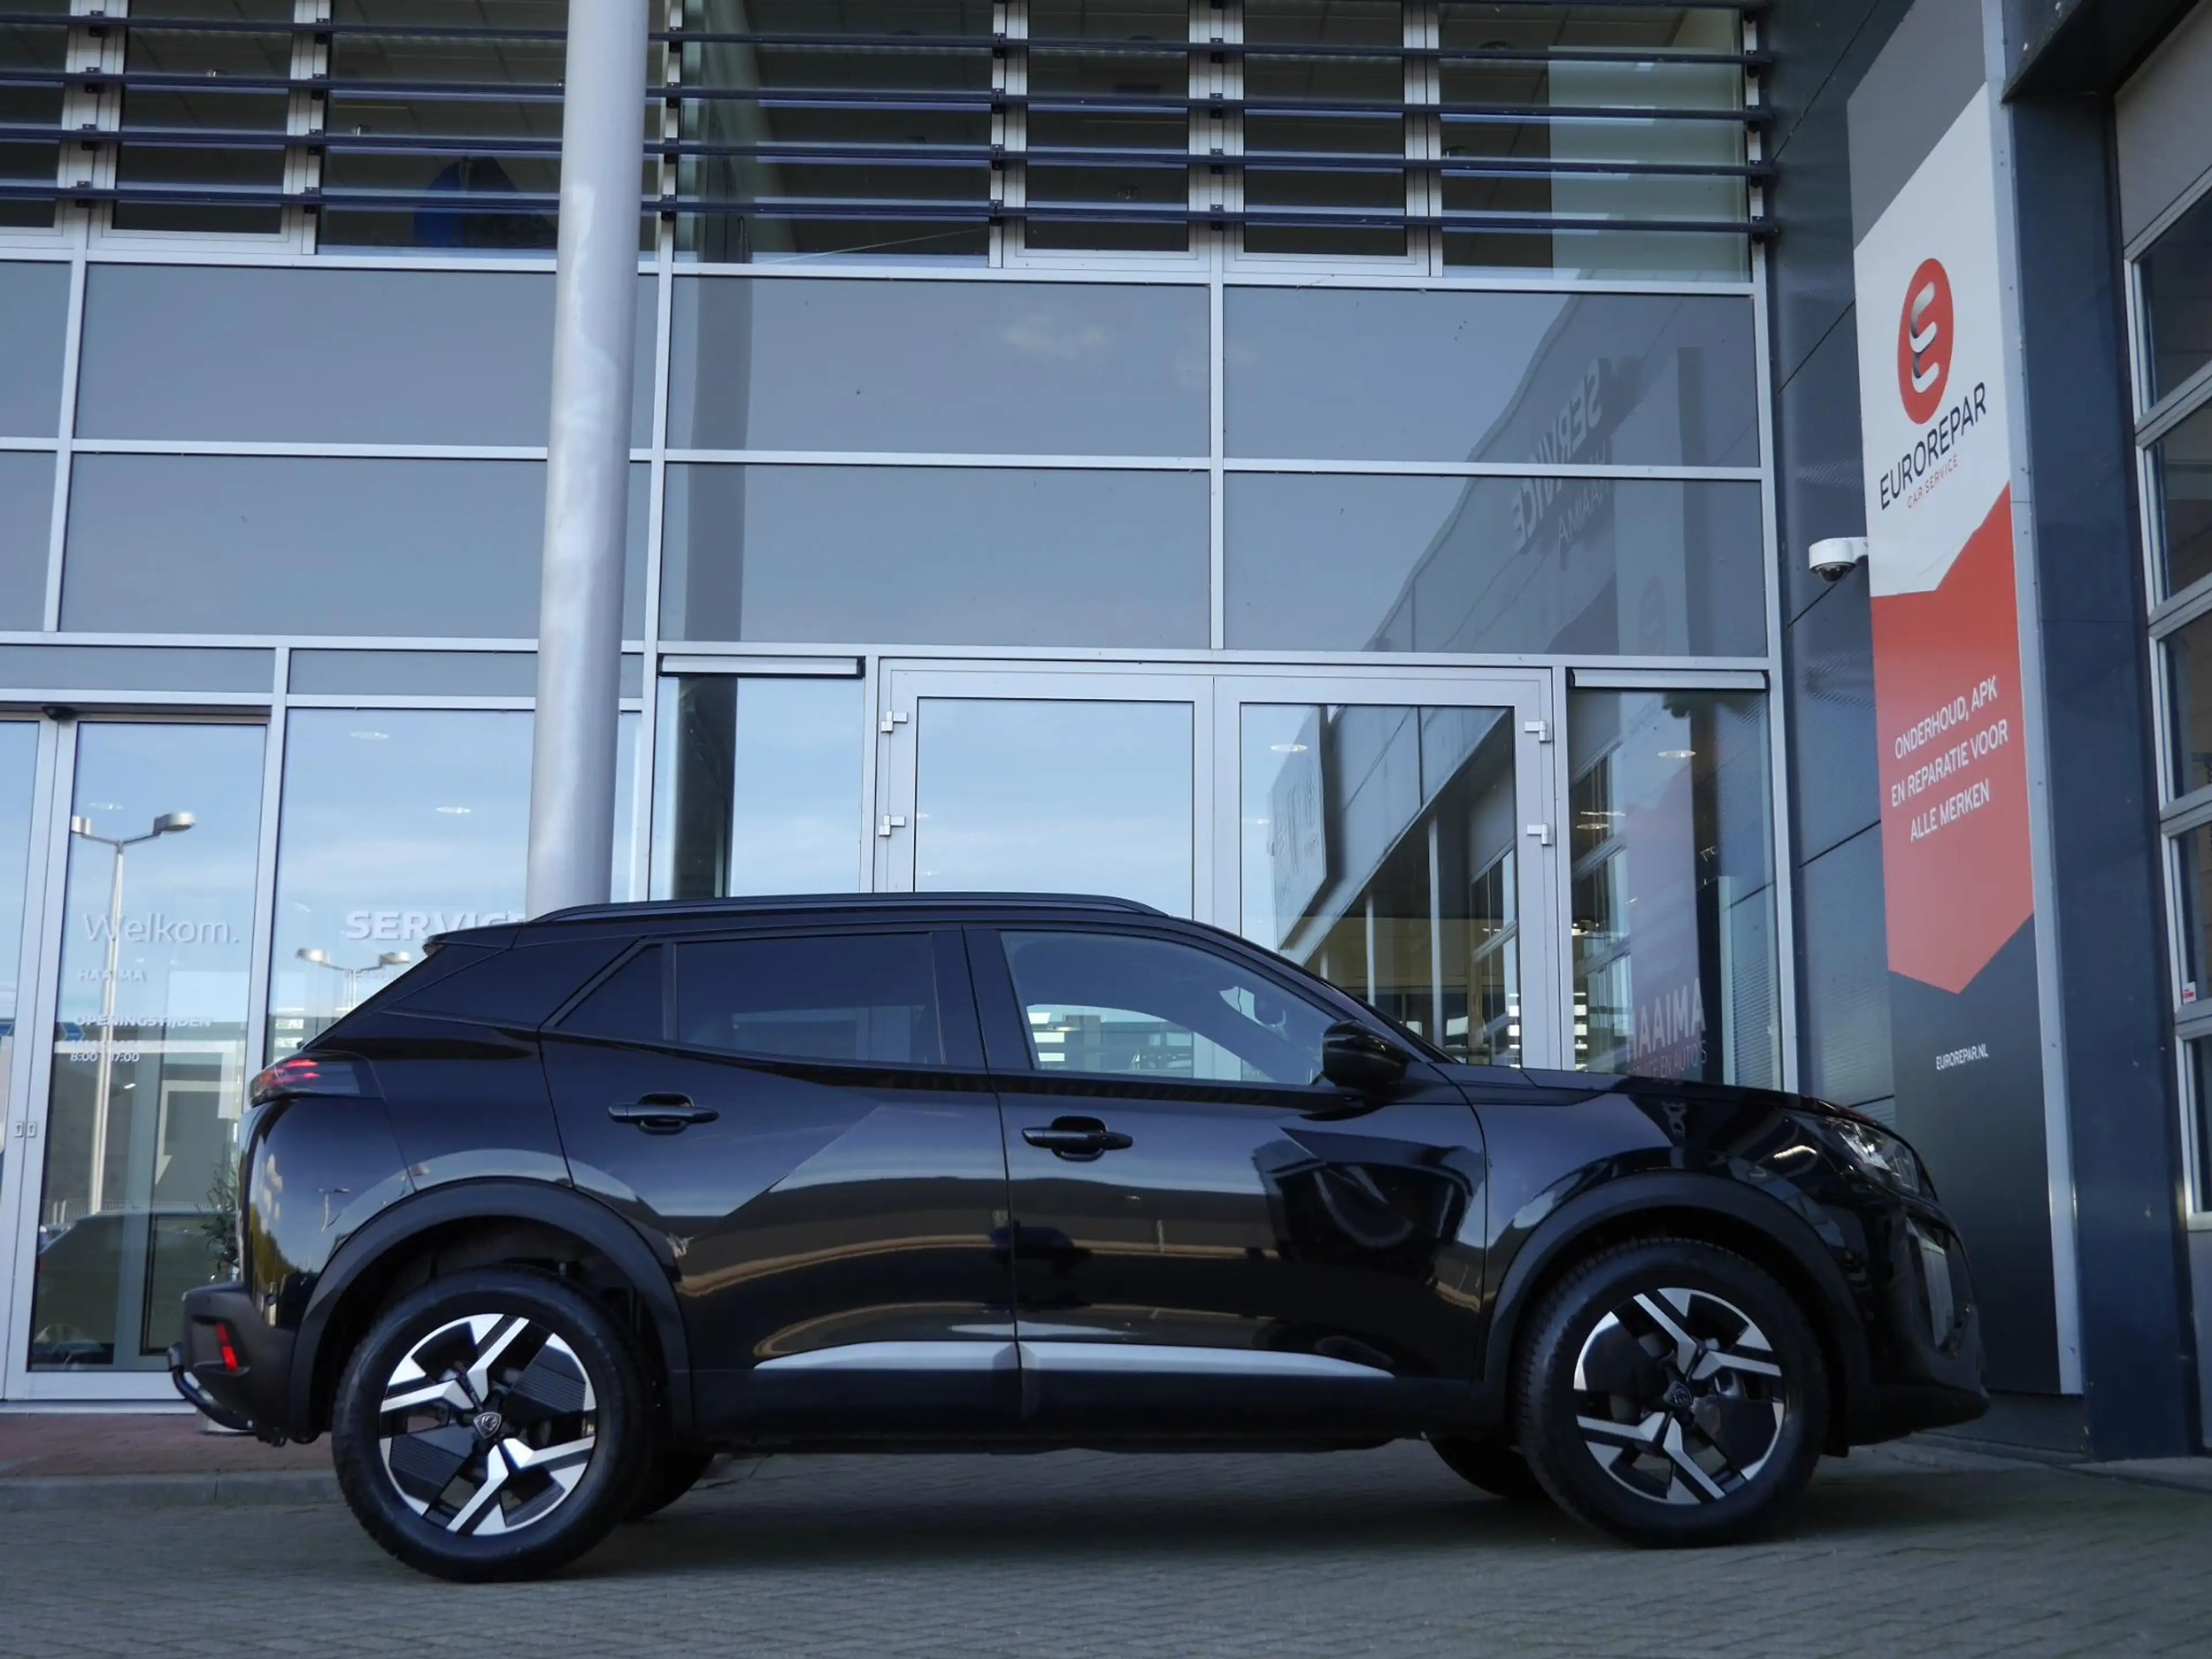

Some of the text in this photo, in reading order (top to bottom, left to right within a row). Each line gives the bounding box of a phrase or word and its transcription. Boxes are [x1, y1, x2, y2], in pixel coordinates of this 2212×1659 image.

[1880, 382, 1986, 510] EUROREPAR
[1907, 454, 1959, 509] CAR SERVICE
[1895, 675, 1998, 759] ONDERHOUD, APK
[1891, 719, 2008, 807] EN REPARATIE VOOR
[1910, 778, 1990, 843] ALLE MERKEN
[82, 912, 240, 944] Welkom.
[345, 910, 525, 941] SERVI
[78, 968, 146, 981] HAAMA
